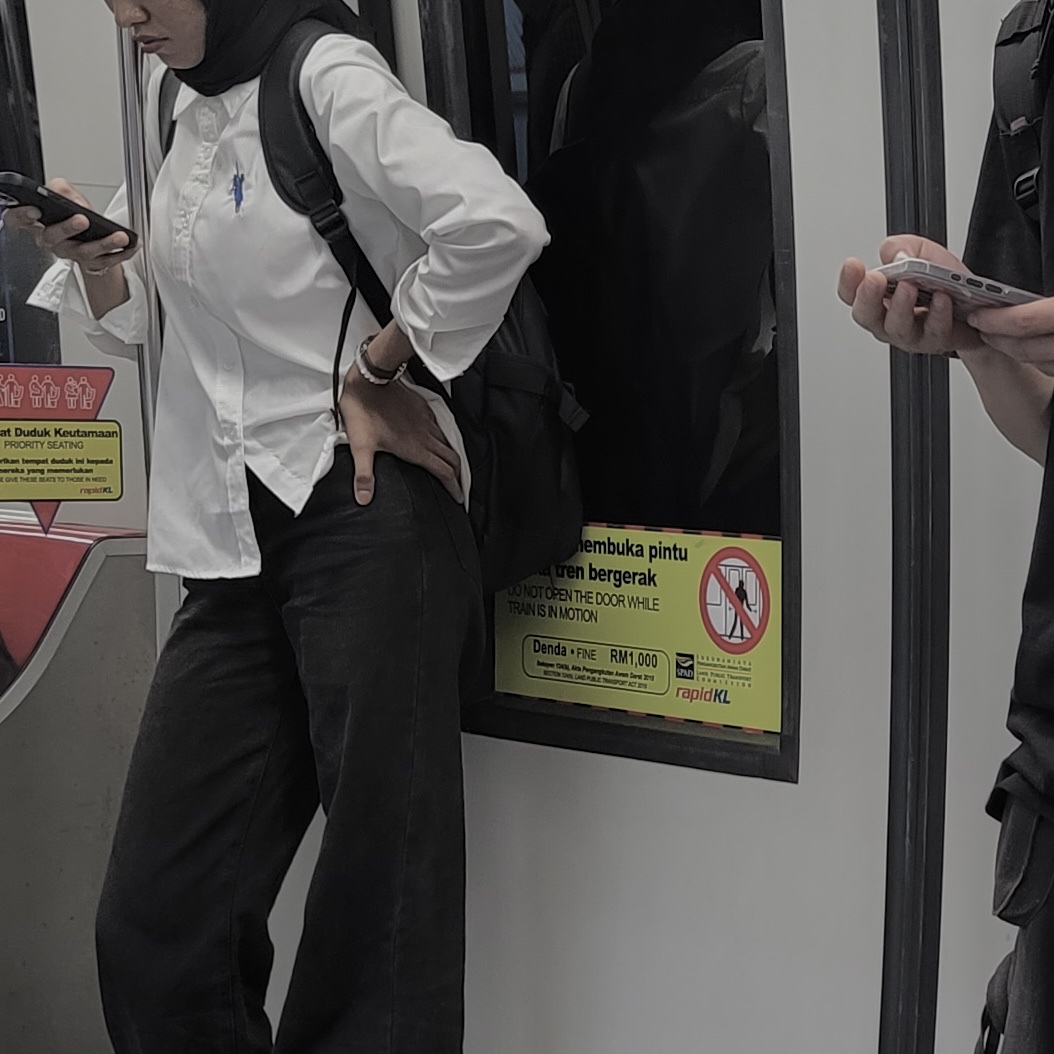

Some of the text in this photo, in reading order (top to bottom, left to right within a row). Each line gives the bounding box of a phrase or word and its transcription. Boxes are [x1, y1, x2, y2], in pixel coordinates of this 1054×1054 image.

[15, 428, 51, 437] Duduk
[54, 428, 118, 438] Keutamaan
[4, 441, 84, 449] PRIORITY SEATING
[649, 541, 688, 563] pintu
[555, 564, 584, 580] tren
[589, 563, 657, 588] bergerak
[524, 584, 544, 598] NOT
[545, 587, 572, 602] OPEN
[574, 590, 594, 605] THE
[595, 592, 626, 608] DOOR
[627, 596, 660, 612] WHILE
[508, 601, 598, 623] TRAIN IS IN MOTION
[533, 639, 658, 668] Denda FINE RM1,000
[677, 669, 693, 677] SPAD
[676, 686, 731, 704] rapidKL
